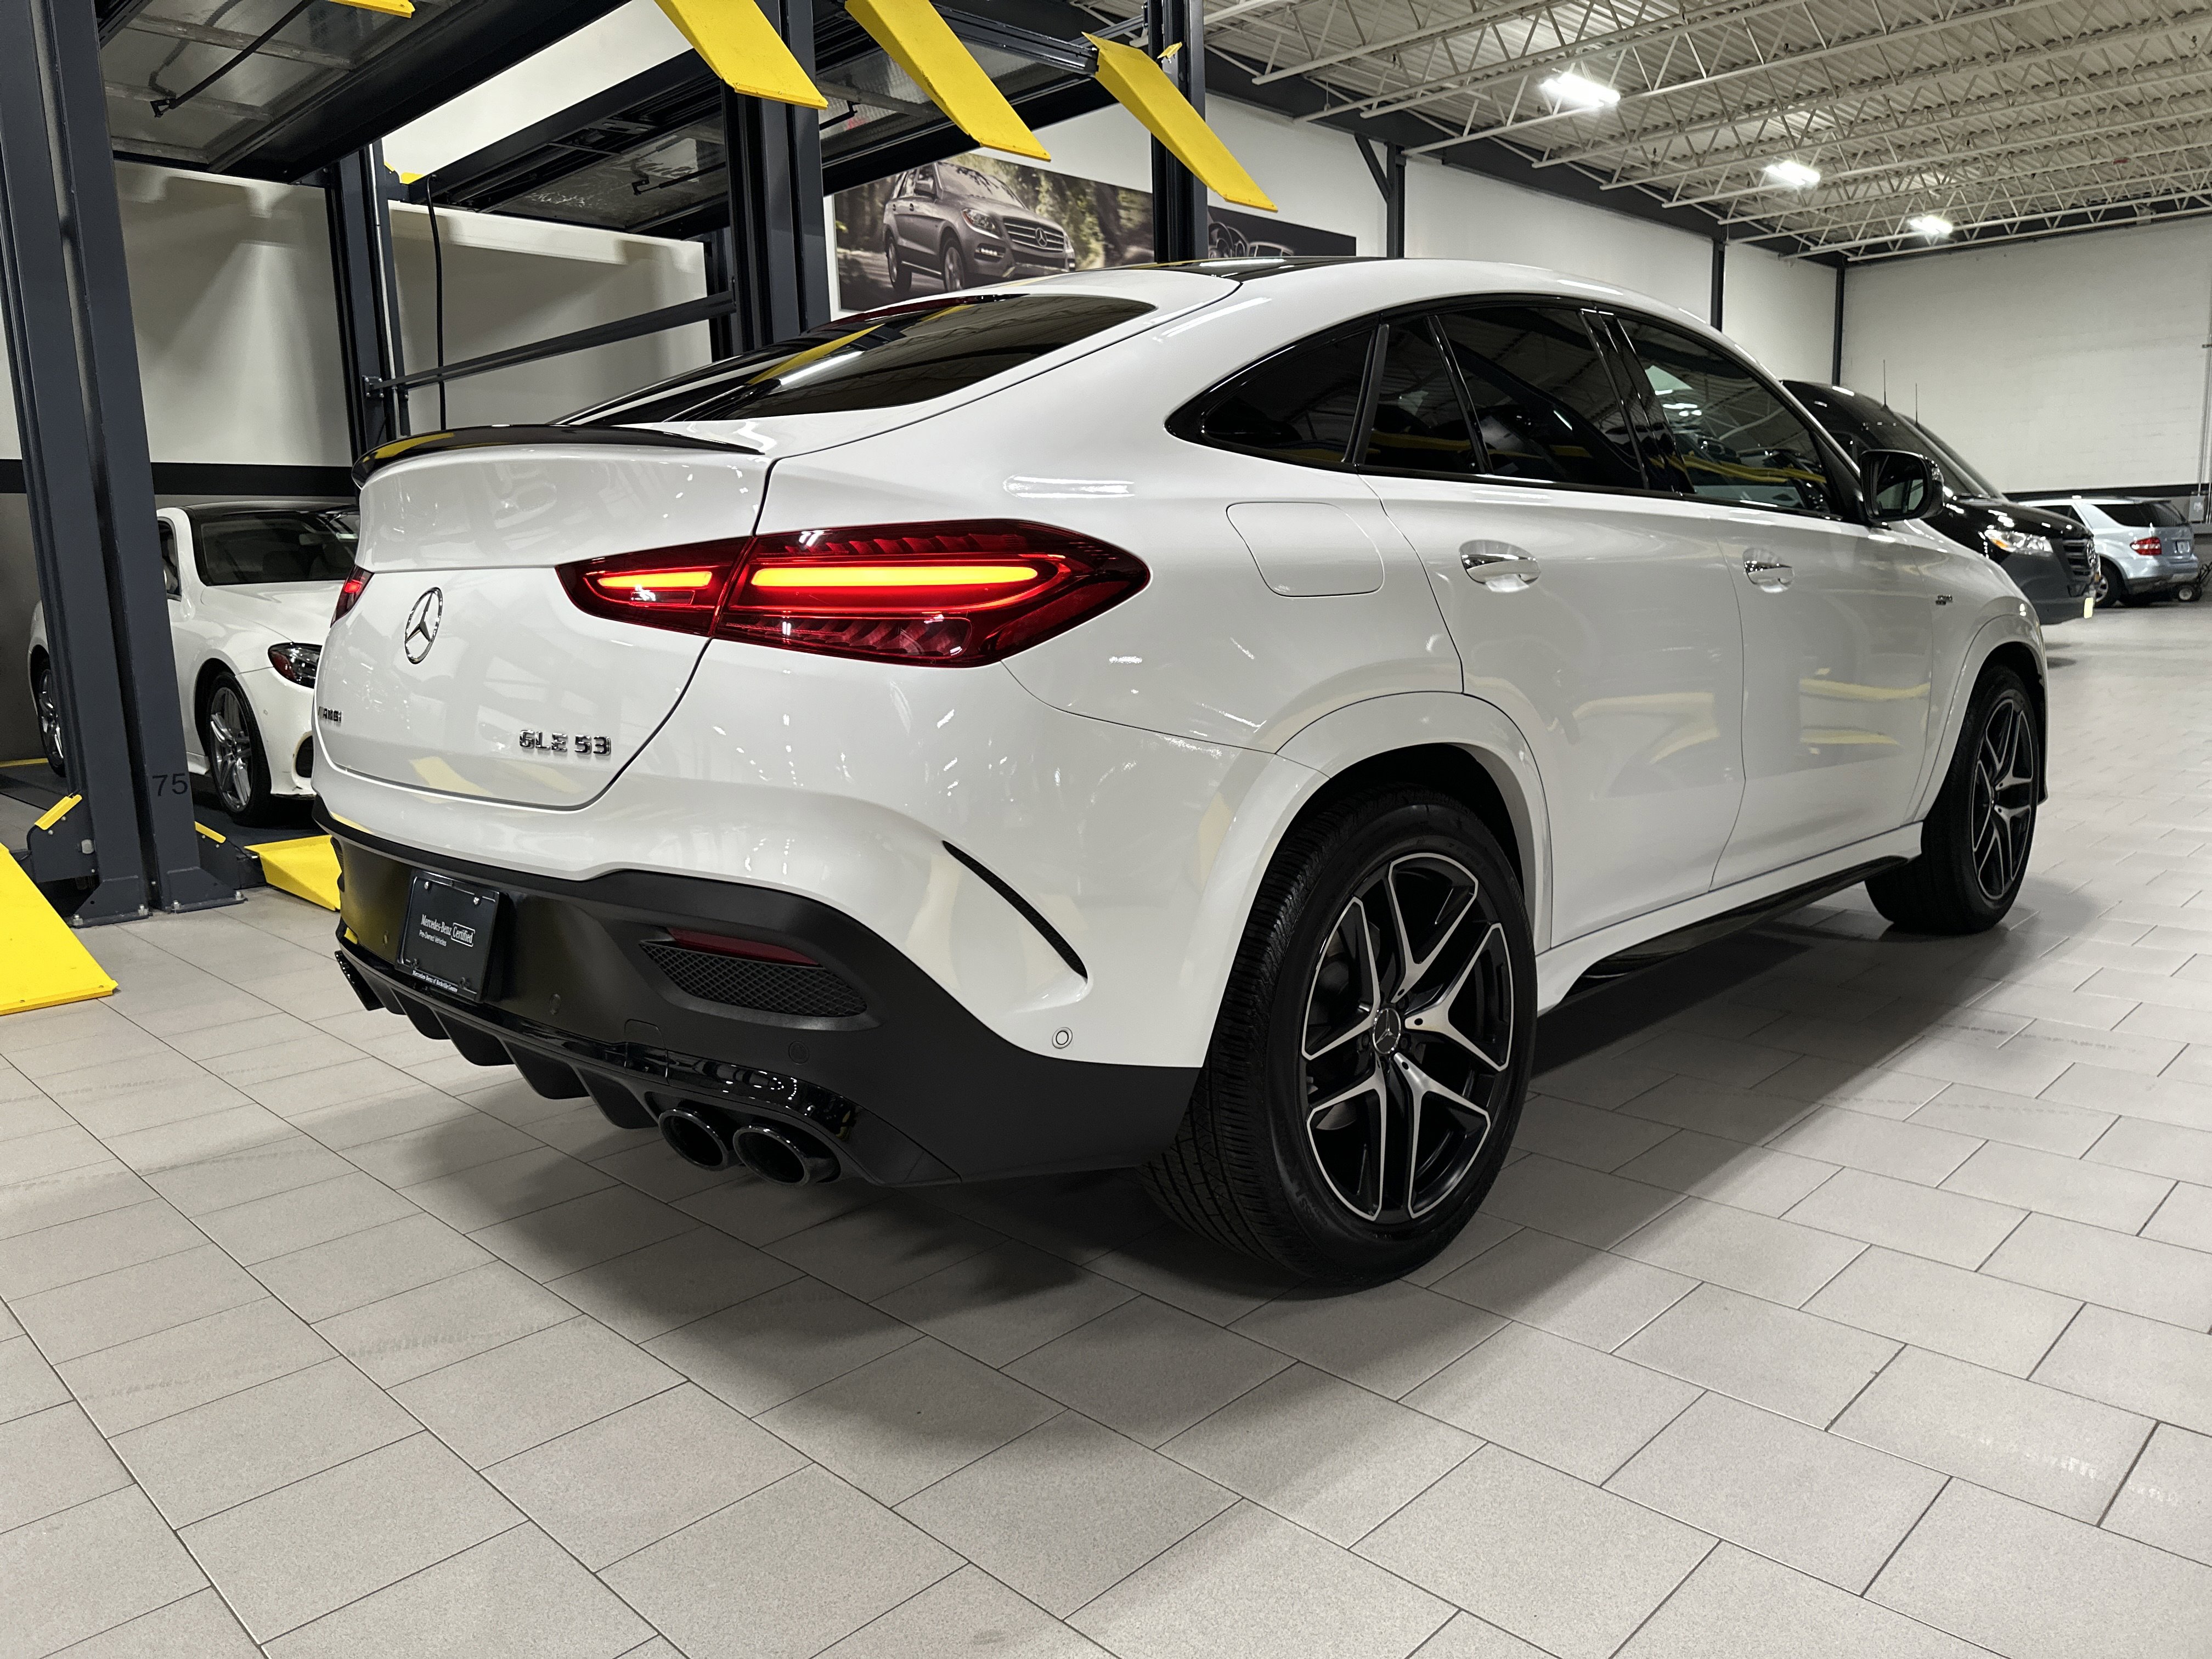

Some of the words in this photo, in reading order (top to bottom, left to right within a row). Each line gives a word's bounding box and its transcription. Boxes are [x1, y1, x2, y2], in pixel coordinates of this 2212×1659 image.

[520, 730, 567, 752] GLE
[575, 736, 611, 755] 53
[152, 773, 188, 796] 75
[421, 914, 452, 935] Mercedes-Benz
[453, 927, 473, 943] Certified
